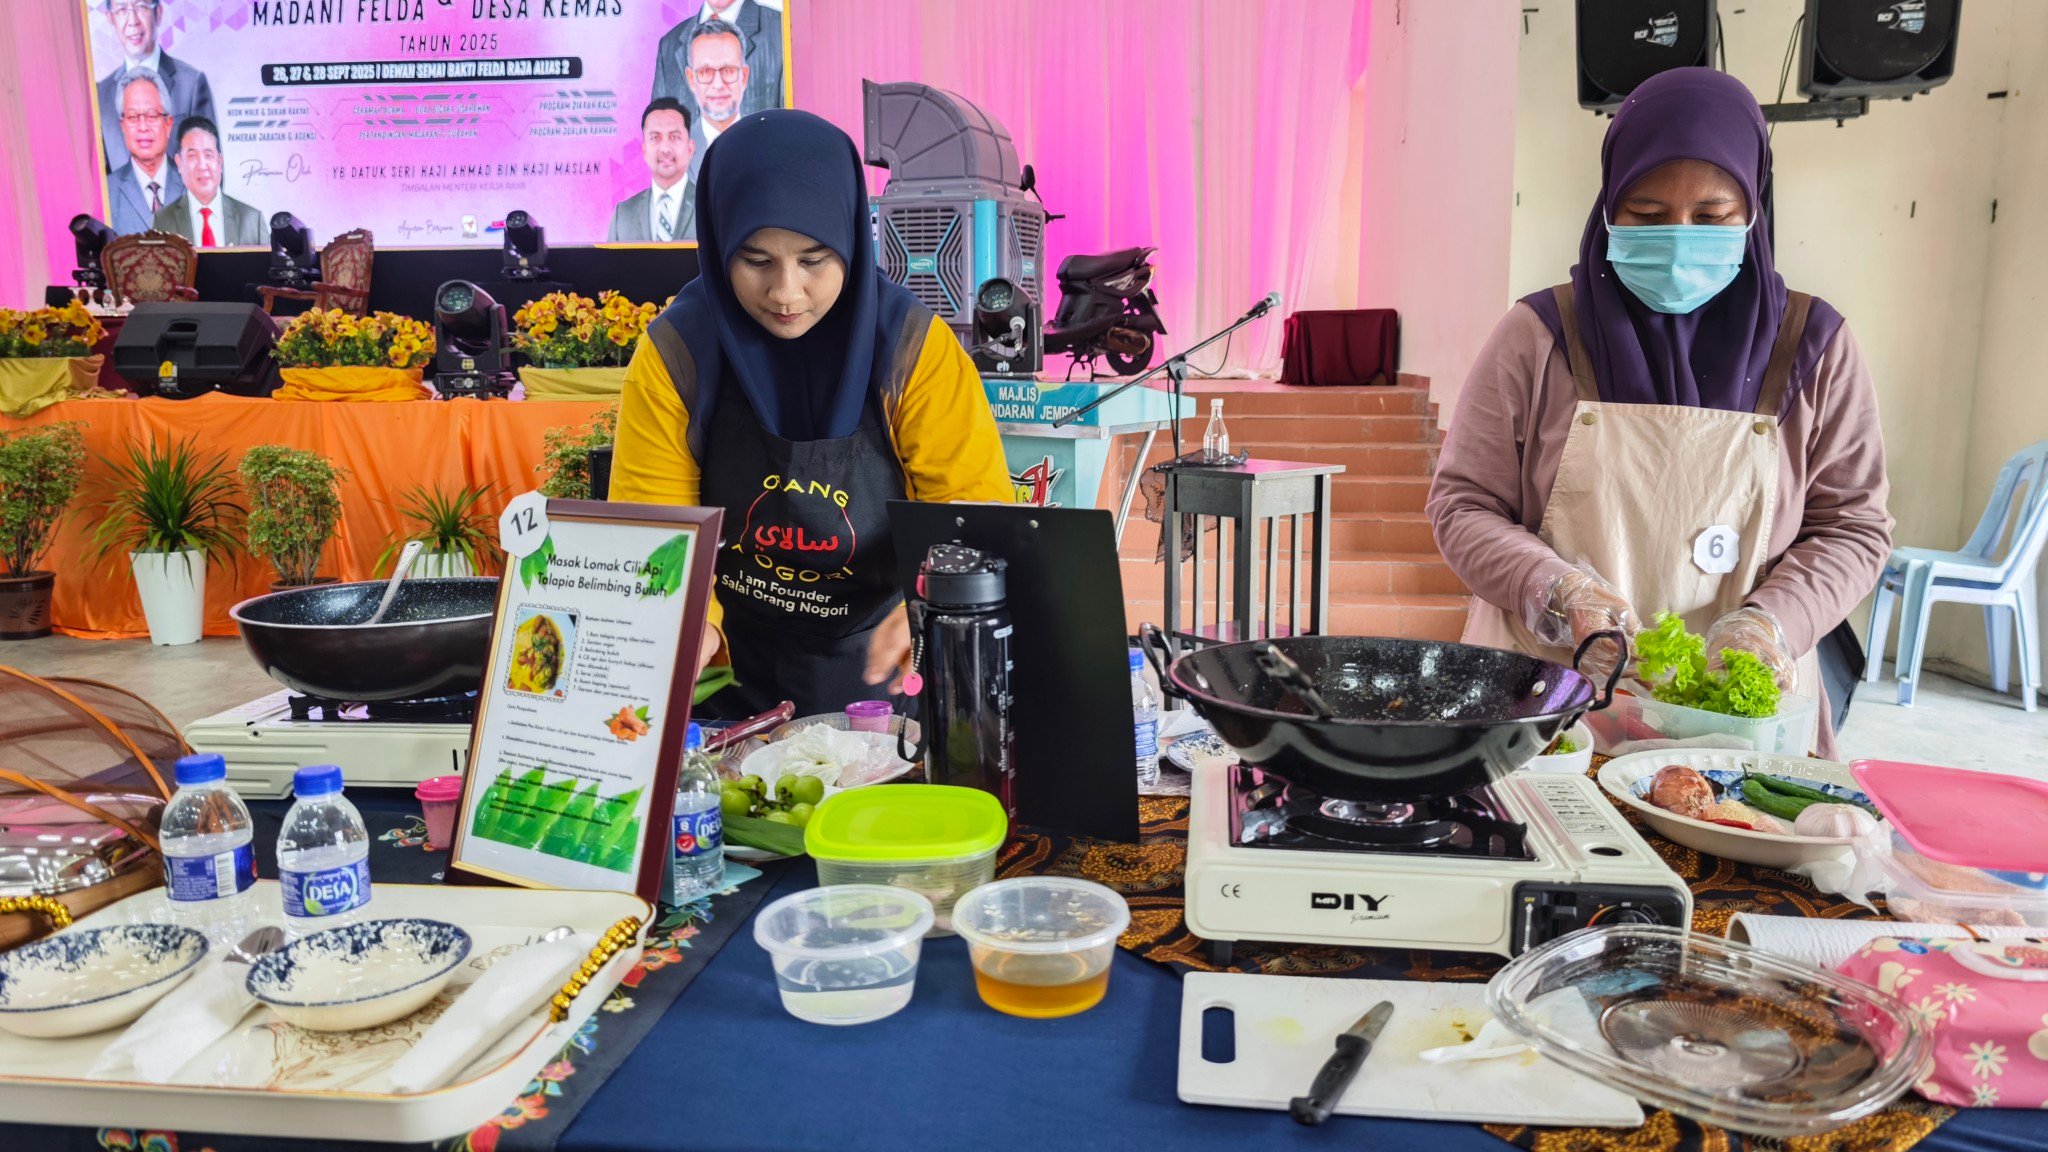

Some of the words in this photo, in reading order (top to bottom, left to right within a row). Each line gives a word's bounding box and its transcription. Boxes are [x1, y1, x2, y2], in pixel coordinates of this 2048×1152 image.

[253, 0, 343, 26] MADANI
[358, 0, 424, 22] FELDA
[472, 0, 528, 19] DESA
[543, 0, 622, 17] KEMAS
[1877, 12, 1894, 22] RCF
[400, 35, 450, 51] TAHUN
[460, 34, 498, 51] 2025
[1634, 29, 1649, 40] RCF
[273, 67, 289, 83] 26,
[289, 66, 302, 81] 27
[303, 66, 312, 81] &
[313, 65, 326, 80] 28
[327, 65, 350, 80] SEPT
[351, 64, 375, 79] 2025
[382, 63, 416, 79] DEWAN
[417, 63, 446, 78] SEMAI
[447, 62, 477, 78] BAKTI
[477, 61, 506, 77] FELDA
[507, 60, 532, 76] RAJA
[533, 60, 561, 75] ALIAS
[561, 59, 570, 75] 2
[539, 101, 570, 111] PROGRAM
[227, 133, 257, 142] PAMERAN
[259, 133, 286, 141] JABATAN
[530, 127, 560, 137] PROGRAM
[333, 167, 344, 178] YB
[351, 166, 386, 178] DATUK
[392, 166, 415, 178] SERI
[421, 165, 446, 177] HAJI
[452, 164, 491, 177] AHMAD
[497, 164, 517, 177] BIN
[523, 163, 549, 175] HAJI
[555, 162, 601, 175] MASLAN
[400, 183, 440, 192] TIMBALAN
[442, 183, 477, 191] MENTERI
[505, 182, 526, 190] RAYA
[999, 386, 1037, 403] MAJLIS
[991, 404, 1034, 419] NDARAN
[511, 507, 539, 536] 12
[1709, 534, 1724, 558] 6
[546, 554, 580, 568] Masak
[583, 556, 619, 572] Lomak
[623, 560, 641, 574] Cili
[642, 561, 663, 577] Api
[537, 573, 575, 590] Talapia
[577, 577, 631, 596] Belimbing
[635, 583, 667, 597] Buluh
[740, 570, 743, 579] I
[745, 575, 766, 589] am
[770, 582, 831, 603] Founder
[721, 574, 750, 595] Salai
[753, 589, 796, 612] Orang
[799, 601, 848, 618] Nogori
[309, 881, 351, 901] DESA
[1221, 884, 1241, 898] CE
[1311, 892, 1388, 911] DIY
[1350, 913, 1390, 924] Premium
